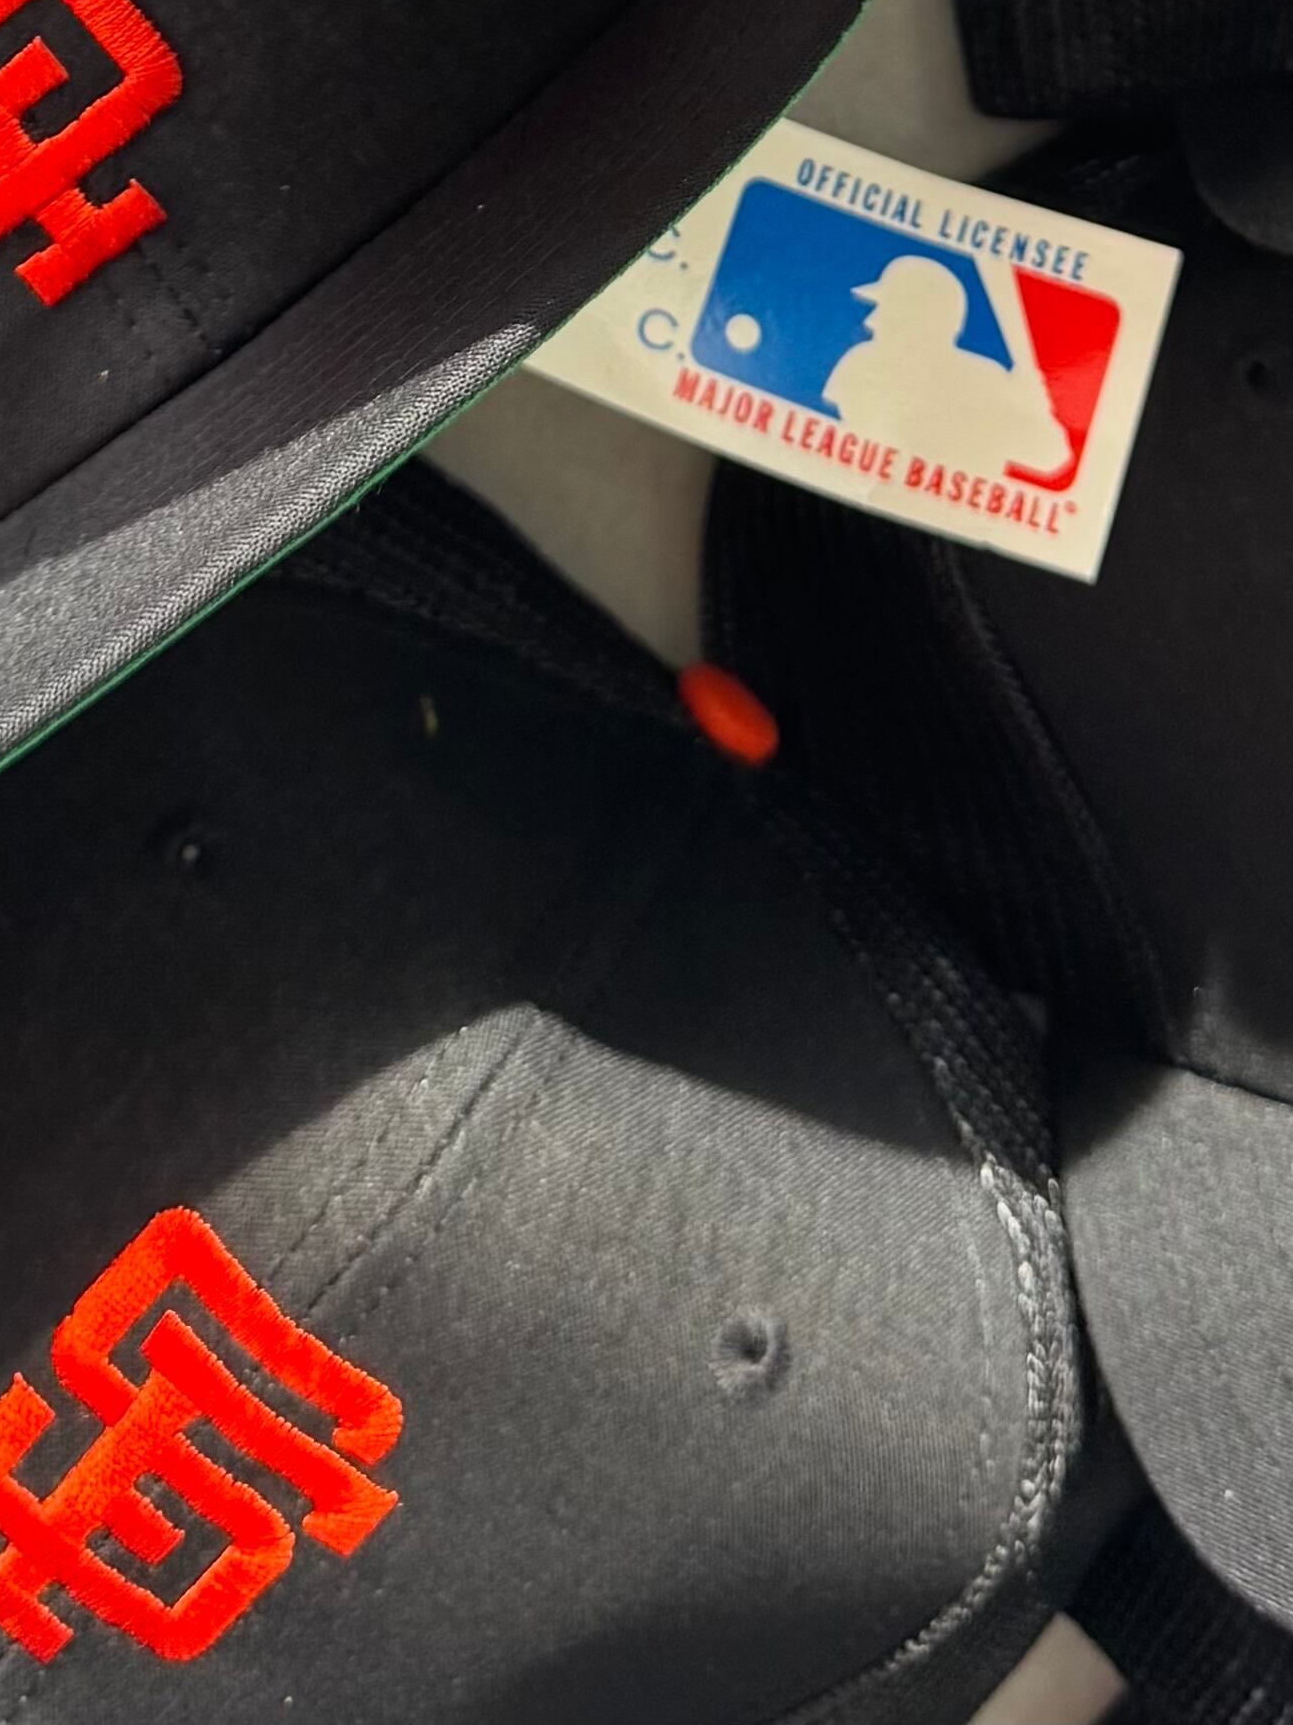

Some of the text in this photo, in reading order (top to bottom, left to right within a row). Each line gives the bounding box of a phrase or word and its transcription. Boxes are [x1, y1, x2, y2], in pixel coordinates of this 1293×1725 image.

[796, 157, 1090, 281] OFFICIAL LICENSEE
[672, 366, 776, 435] MAJOR
[780, 410, 900, 481] LEAGUE
